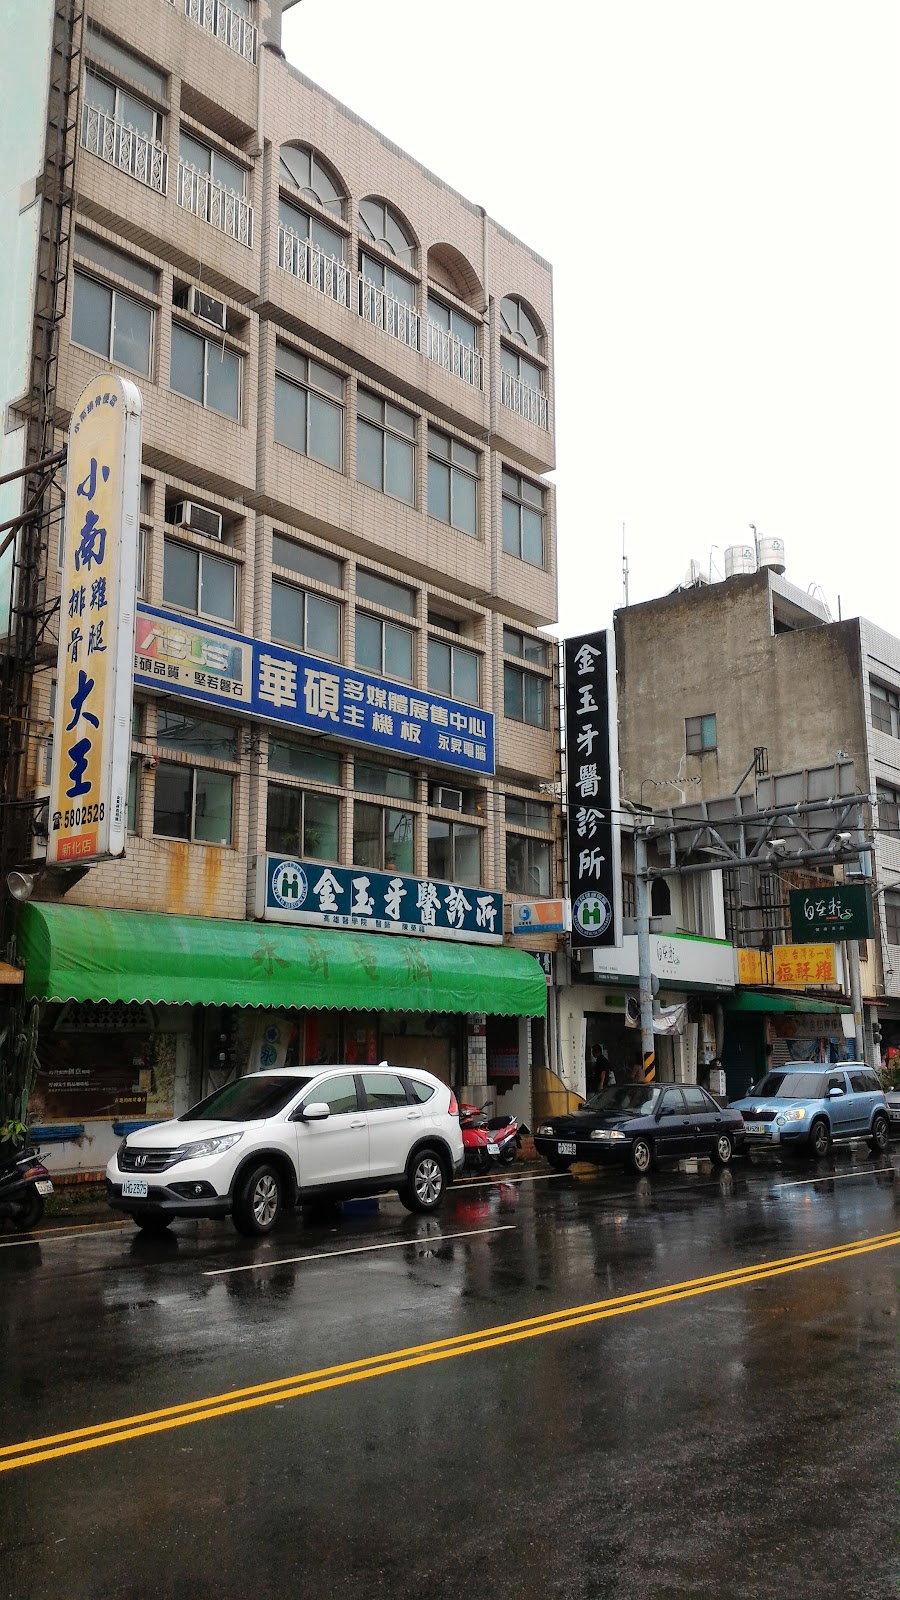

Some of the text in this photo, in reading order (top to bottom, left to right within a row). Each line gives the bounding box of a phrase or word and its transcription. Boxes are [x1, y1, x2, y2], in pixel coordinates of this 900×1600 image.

[74, 457, 110, 572] 小南
[258, 653, 340, 723] 華碩
[343, 677, 487, 739] 多媒體展售中心
[65, 669, 100, 798] 大王
[343, 704, 421, 744] 主機板
[437, 733, 487, 762] 永昇電腦
[574, 643, 605, 880] 金玉牙醫診所
[62, 838, 92, 858] 新化店
[63, 803, 105, 830] 5802528
[313, 868, 498, 932] 金玉牙醫診所
